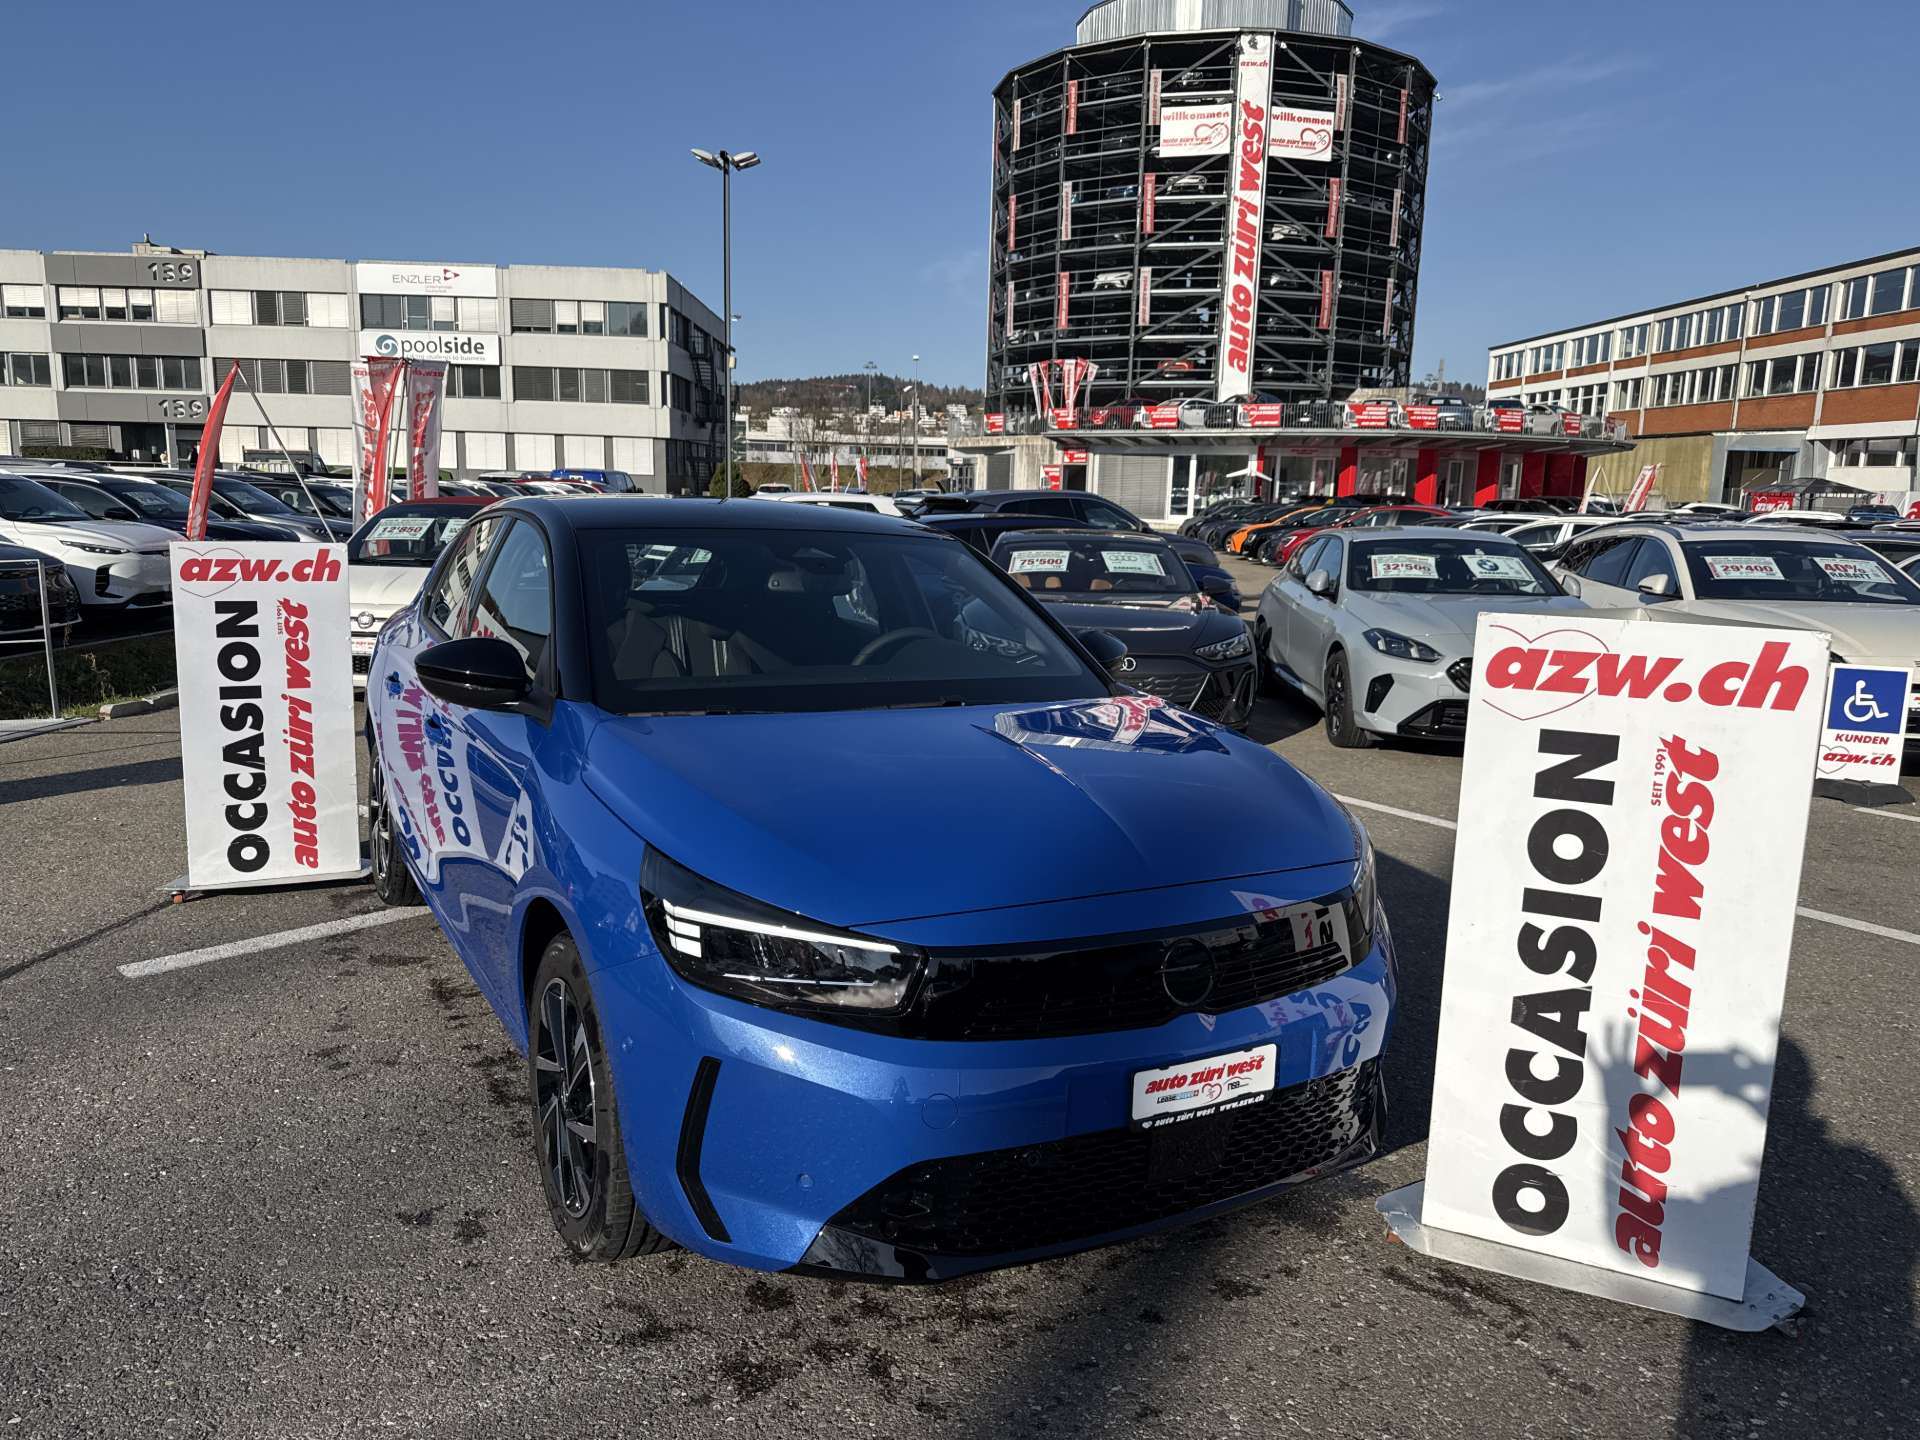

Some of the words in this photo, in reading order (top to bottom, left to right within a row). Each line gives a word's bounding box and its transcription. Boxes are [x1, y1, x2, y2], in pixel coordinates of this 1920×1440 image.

[1163, 111, 1229, 121] willkommen
[1271, 111, 1332, 125] willkommen
[1239, 99, 1265, 192] west
[1231, 195, 1260, 283] züri
[148, 262, 193, 282] 139
[392, 274, 442, 284] ENZLER
[1227, 284, 1254, 374] auto
[401, 336, 485, 357] poolside
[159, 400, 203, 418] 139
[180, 548, 341, 582] azw.ch
[1721, 564, 1774, 572] 29'400
[1824, 563, 1866, 574] 40%
[277, 597, 311, 690] west
[1485, 641, 1809, 711] azw.ch
[214, 601, 270, 873] OCCASION
[280, 693, 315, 779] züri
[1835, 733, 1890, 745] KUNDEN
[1654, 748, 1668, 778] 1991
[1822, 752, 1897, 767] azw.ch
[1651, 780, 1664, 807] SEIT
[286, 781, 319, 869] auto
[1652, 734, 1720, 920] west
[1492, 729, 1621, 1237] OCCASION
[1627, 920, 1698, 1099] züri
[1145, 1073, 1188, 1095] auto
[1188, 1063, 1226, 1086] züri
[1227, 1055, 1265, 1078] west
[1154, 1116, 1175, 1128] auto
[1196, 1107, 1216, 1118] west
[1605, 1093, 1676, 1268] auto
